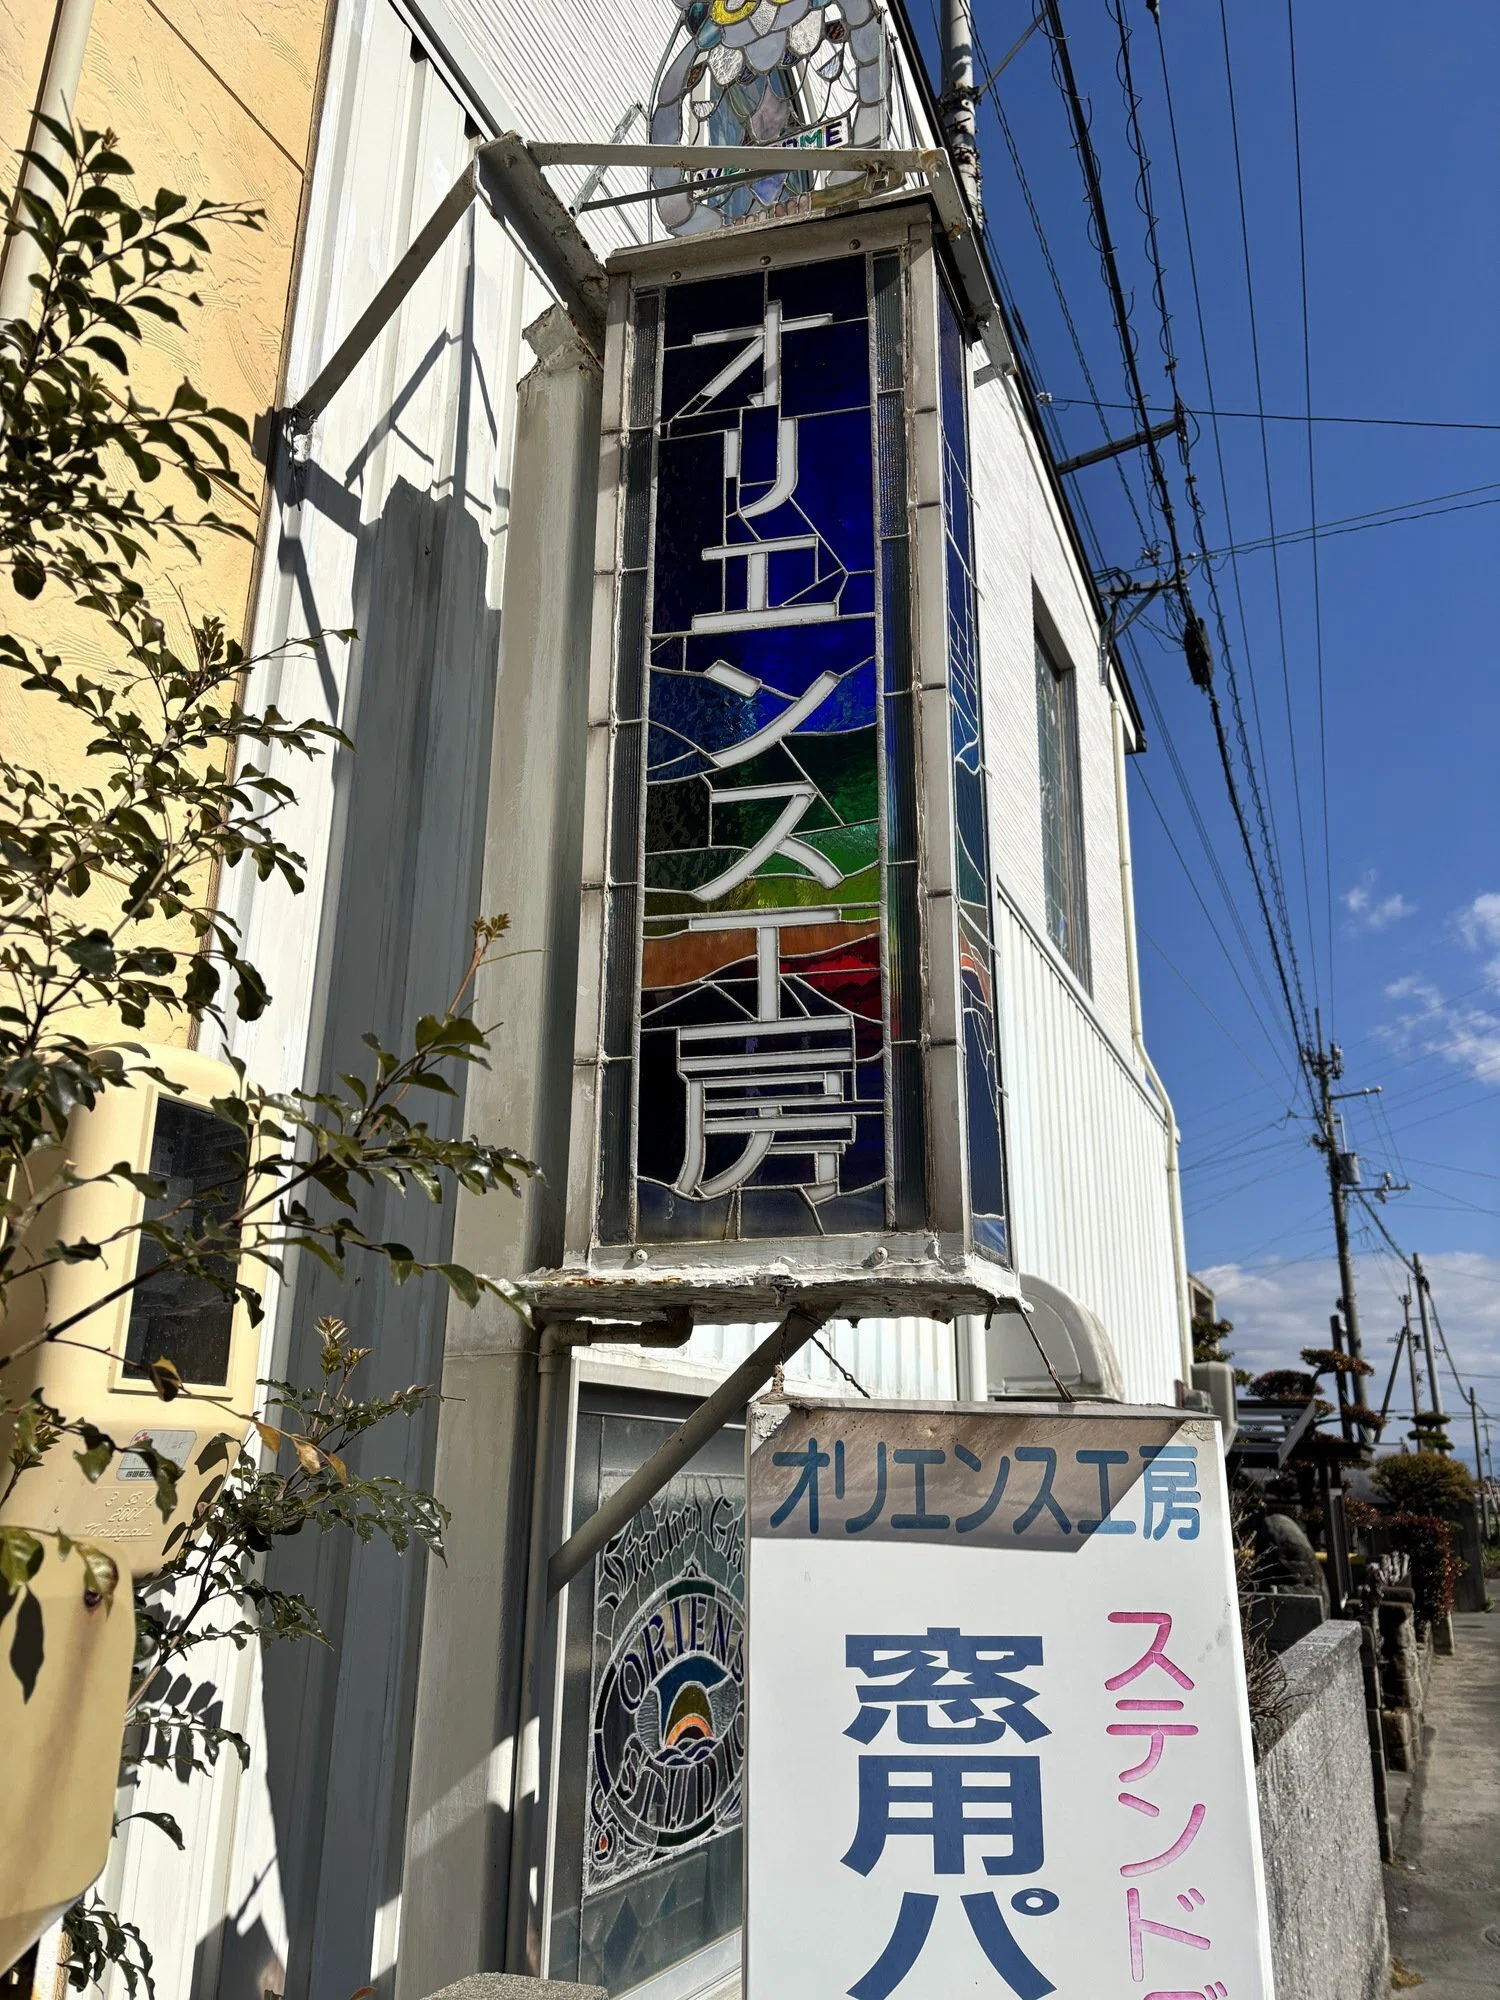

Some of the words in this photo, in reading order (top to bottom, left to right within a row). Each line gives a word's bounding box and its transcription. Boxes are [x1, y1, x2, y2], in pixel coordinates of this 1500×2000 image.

[676, 300, 857, 1206] オリエンス工房
[770, 1437, 1202, 1541] オリエンス工房
[839, 1627, 1060, 2000] 窓用パ
[1105, 1611, 1228, 2000] ステンド
